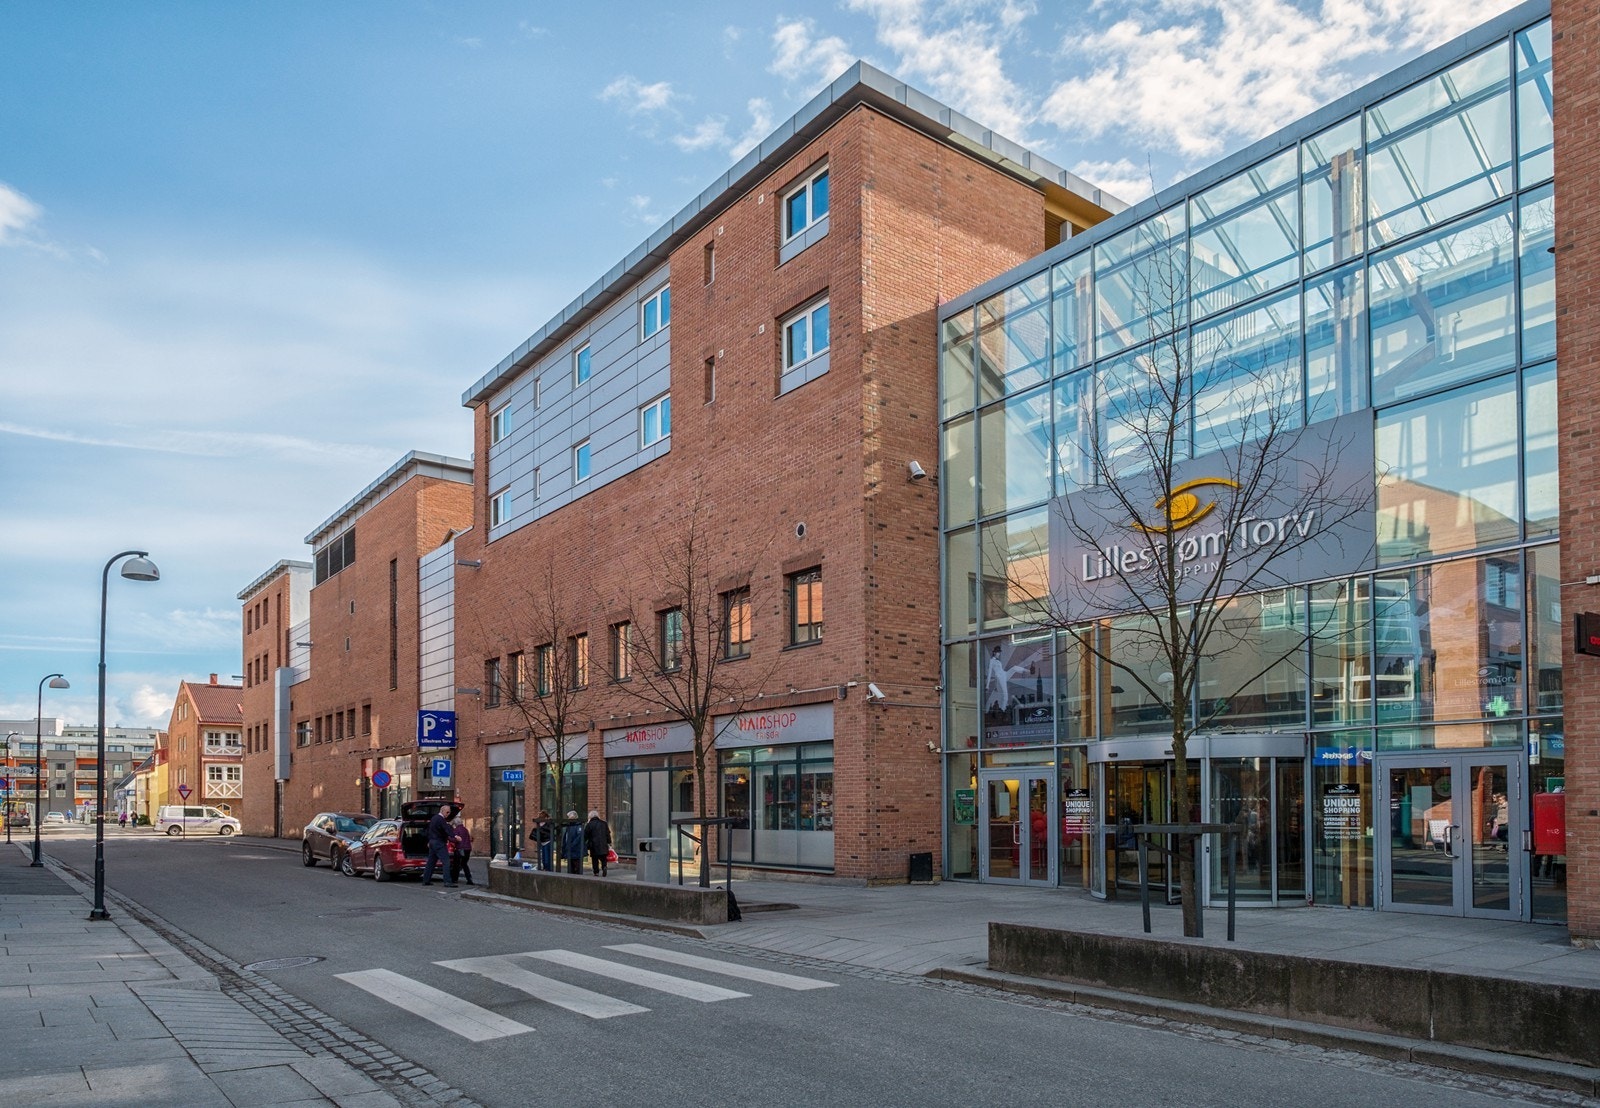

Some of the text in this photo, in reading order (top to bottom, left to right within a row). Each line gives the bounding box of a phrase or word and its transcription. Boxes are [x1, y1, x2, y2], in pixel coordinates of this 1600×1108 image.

[423, 717, 436, 737] P
[739, 712, 797, 731] HAIRSHOP
[626, 727, 668, 743] HAIRSHOP
[436, 761, 446, 775] P
[1065, 800, 1090, 808] UNIQUE
[1323, 798, 1360, 807] UNIQUE
